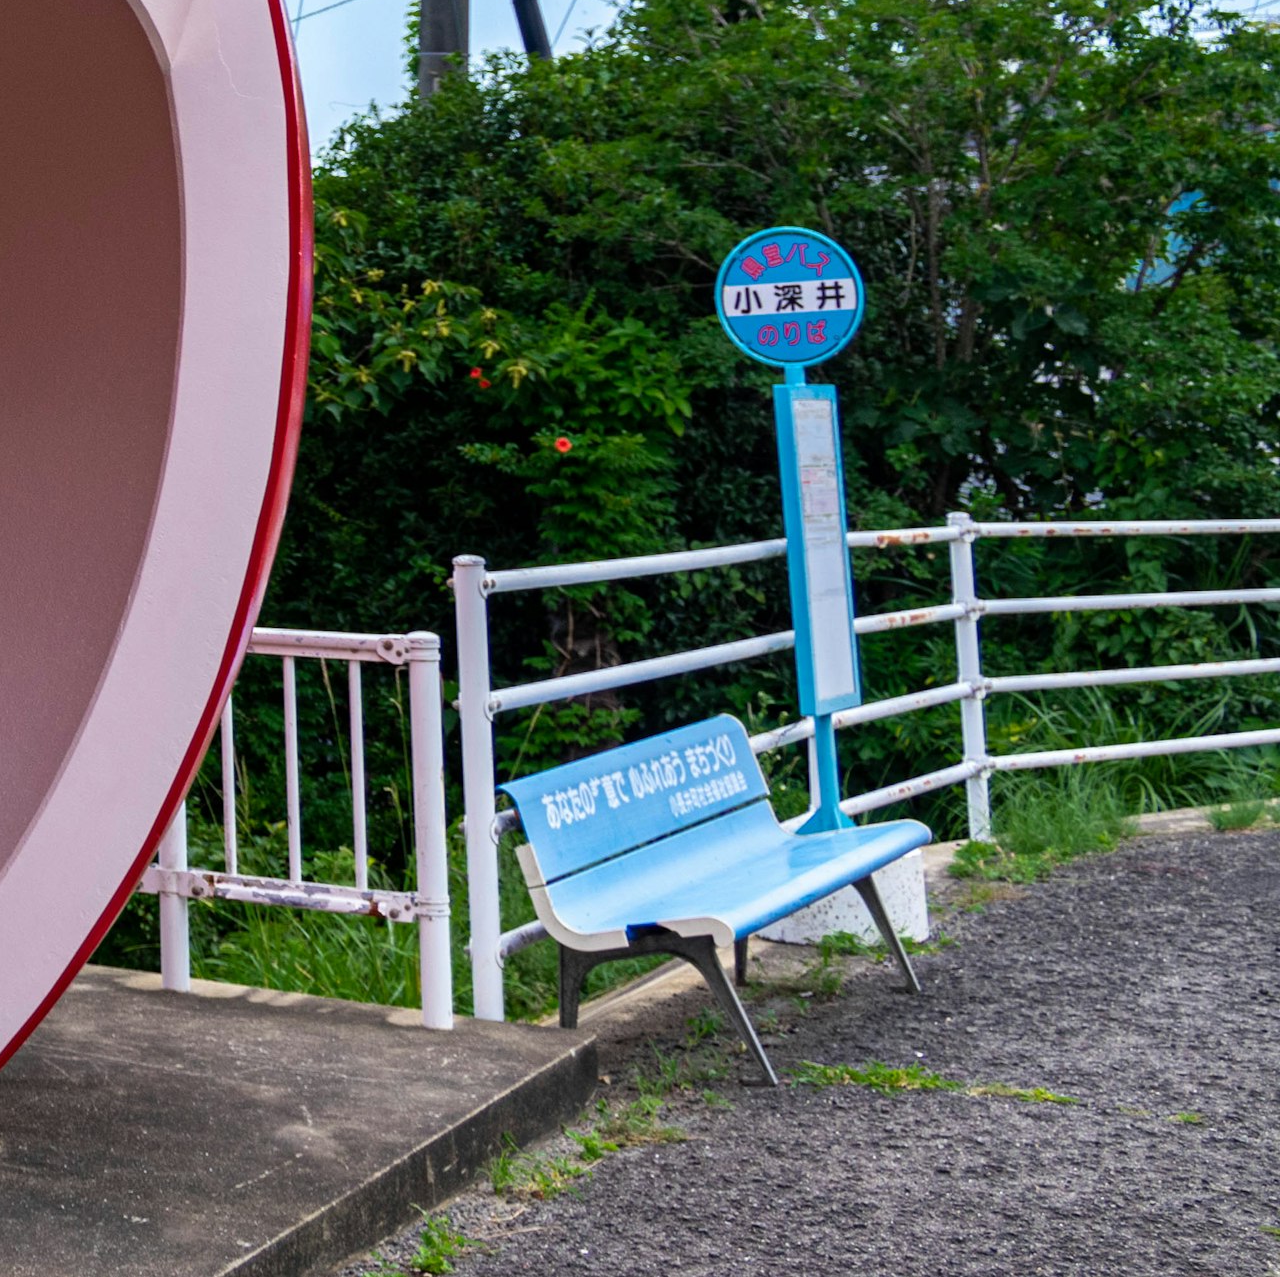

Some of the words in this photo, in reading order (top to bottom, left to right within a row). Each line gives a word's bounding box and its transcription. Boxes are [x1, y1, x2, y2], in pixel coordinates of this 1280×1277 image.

[734, 281, 845, 314] 小深井
[757, 320, 827, 346] のりば
[684, 734, 736, 778] まちづくり
